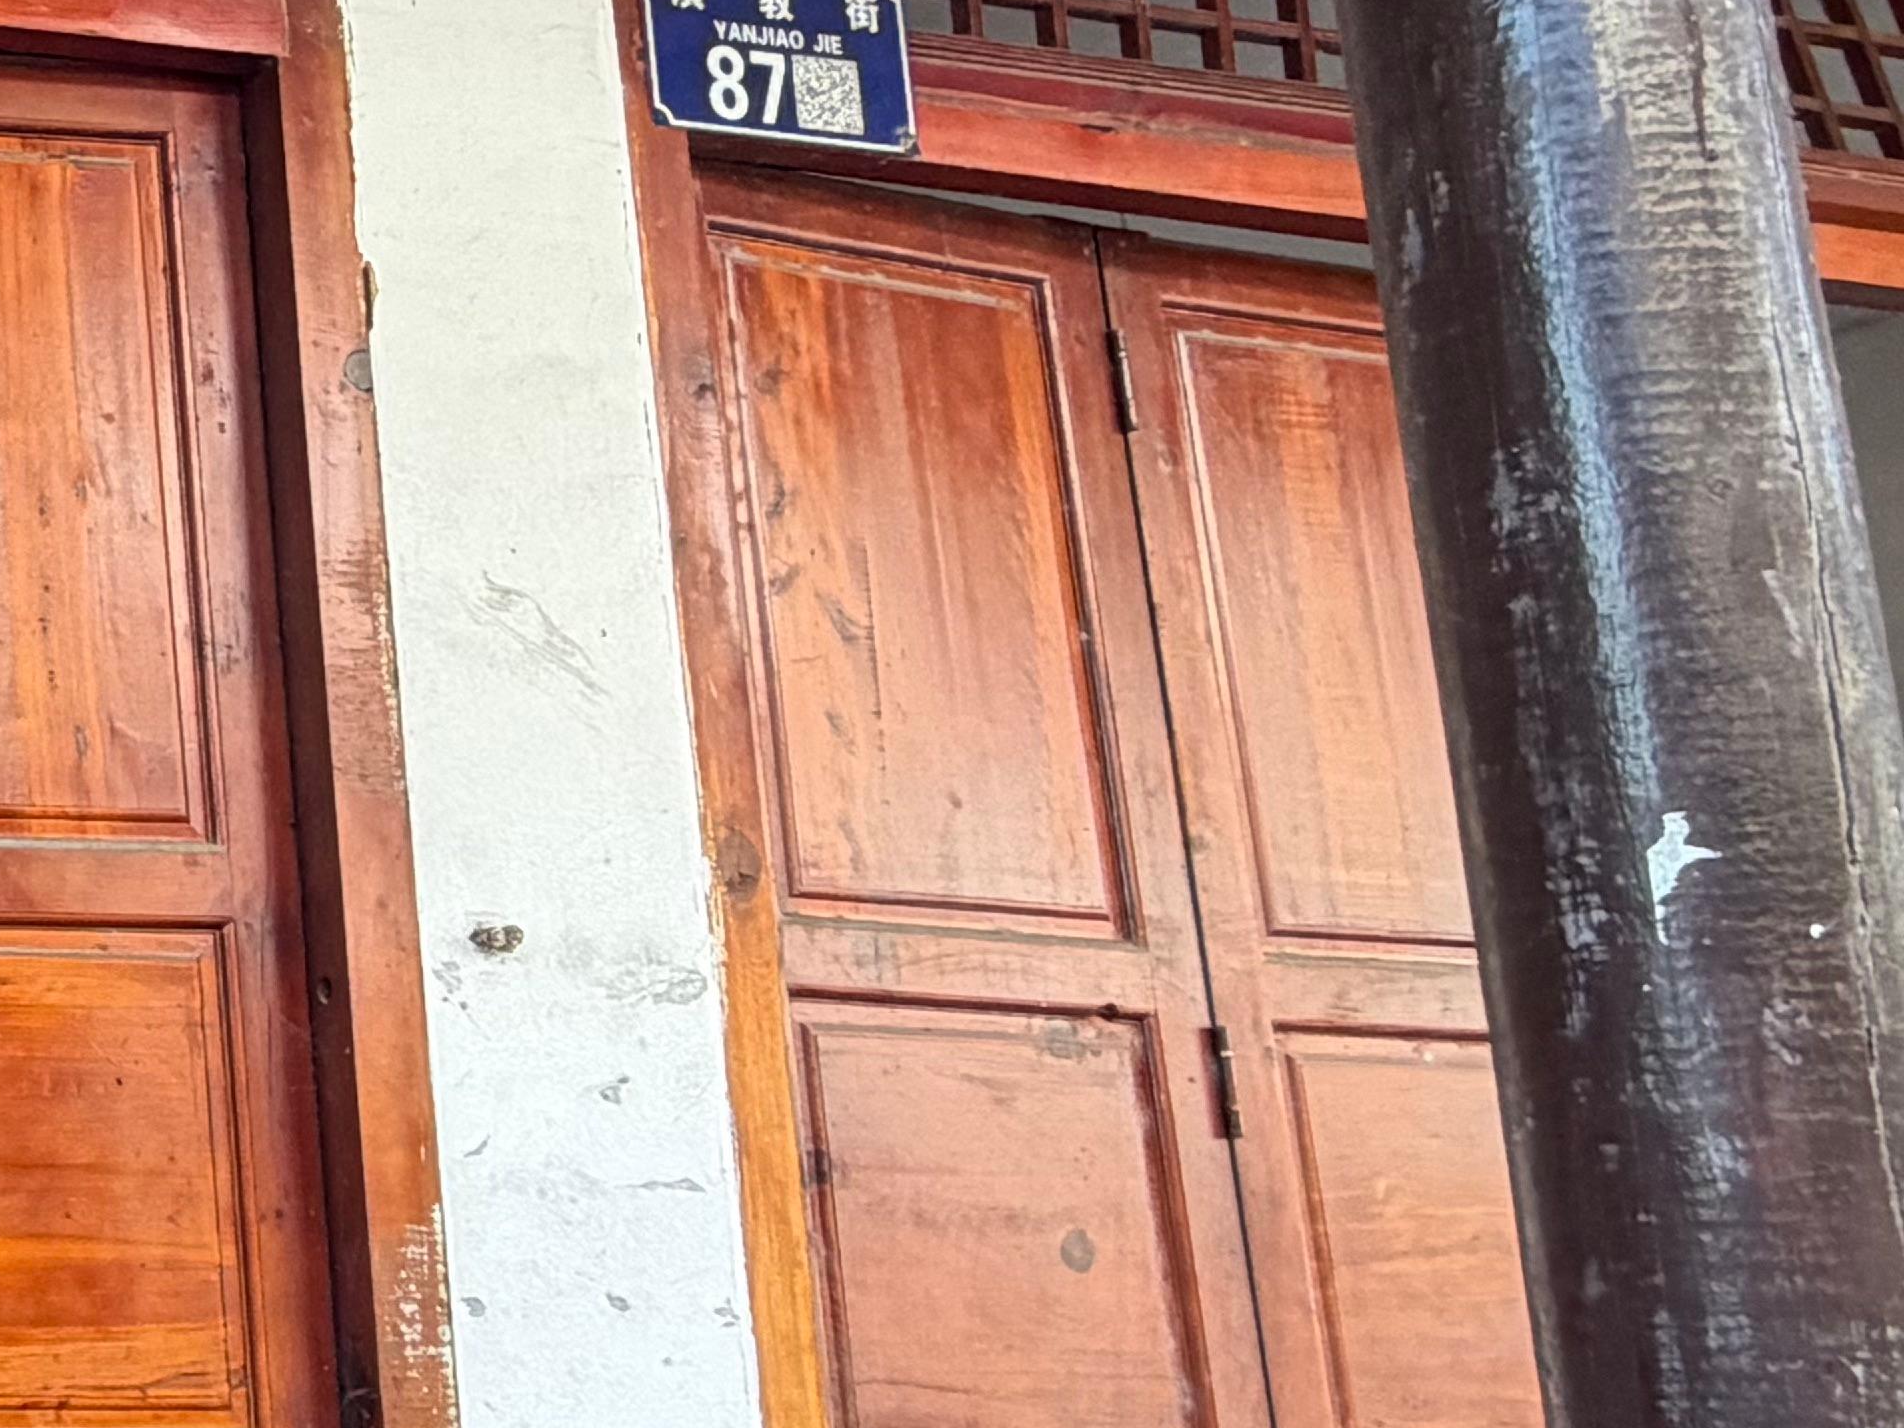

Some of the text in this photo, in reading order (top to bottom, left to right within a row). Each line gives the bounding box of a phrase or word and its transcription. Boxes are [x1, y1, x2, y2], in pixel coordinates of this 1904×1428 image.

[713, 19, 843, 55] YANJIAO JIE
[706, 45, 786, 125] 87
